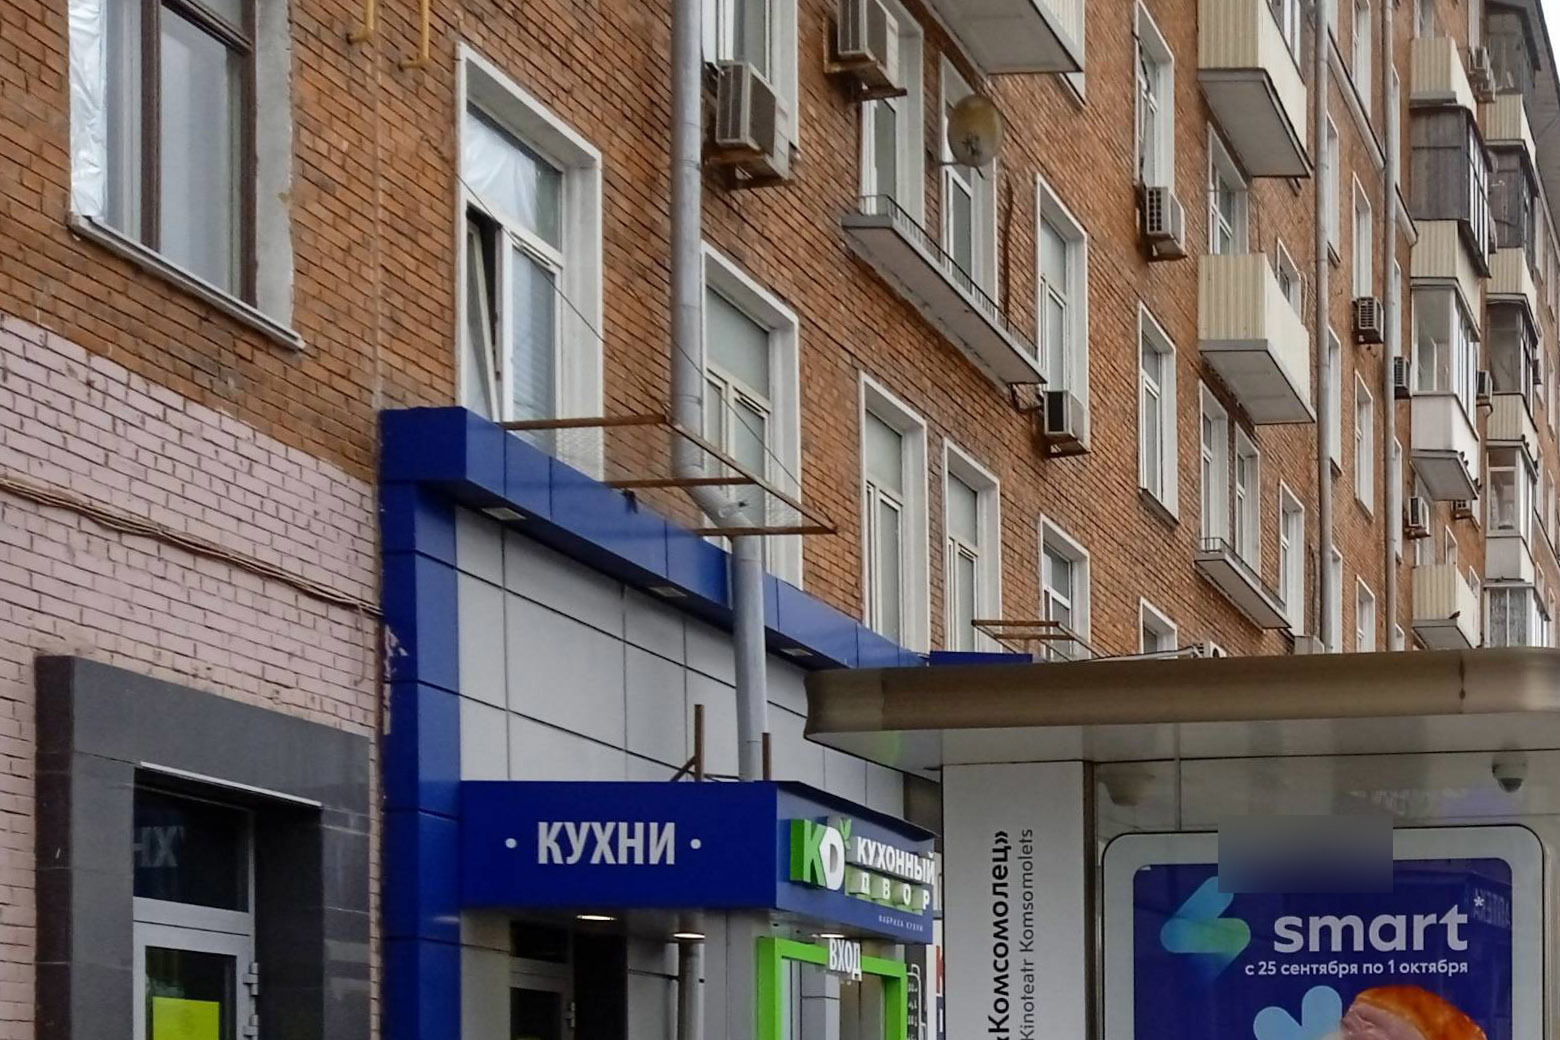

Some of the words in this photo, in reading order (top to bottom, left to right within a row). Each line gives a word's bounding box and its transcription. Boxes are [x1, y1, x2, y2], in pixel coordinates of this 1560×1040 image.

[537, 821, 676, 865] КУХНИ
[856, 836, 936, 887] КУХОННЫЙ
[860, 871, 931, 911] ДВОР
[1017, 828, 1034, 954] Komsomolets
[1273, 904, 1468, 953] smart
[828, 938, 863, 982] ВХОД
[1245, 963, 1255, 976] с
[1258, 961, 1277, 976] 25
[1280, 960, 1358, 978] сентября
[1362, 962, 1384, 975] по
[1387, 959, 1395, 975] 1
[1399, 959, 1469, 977] октября
